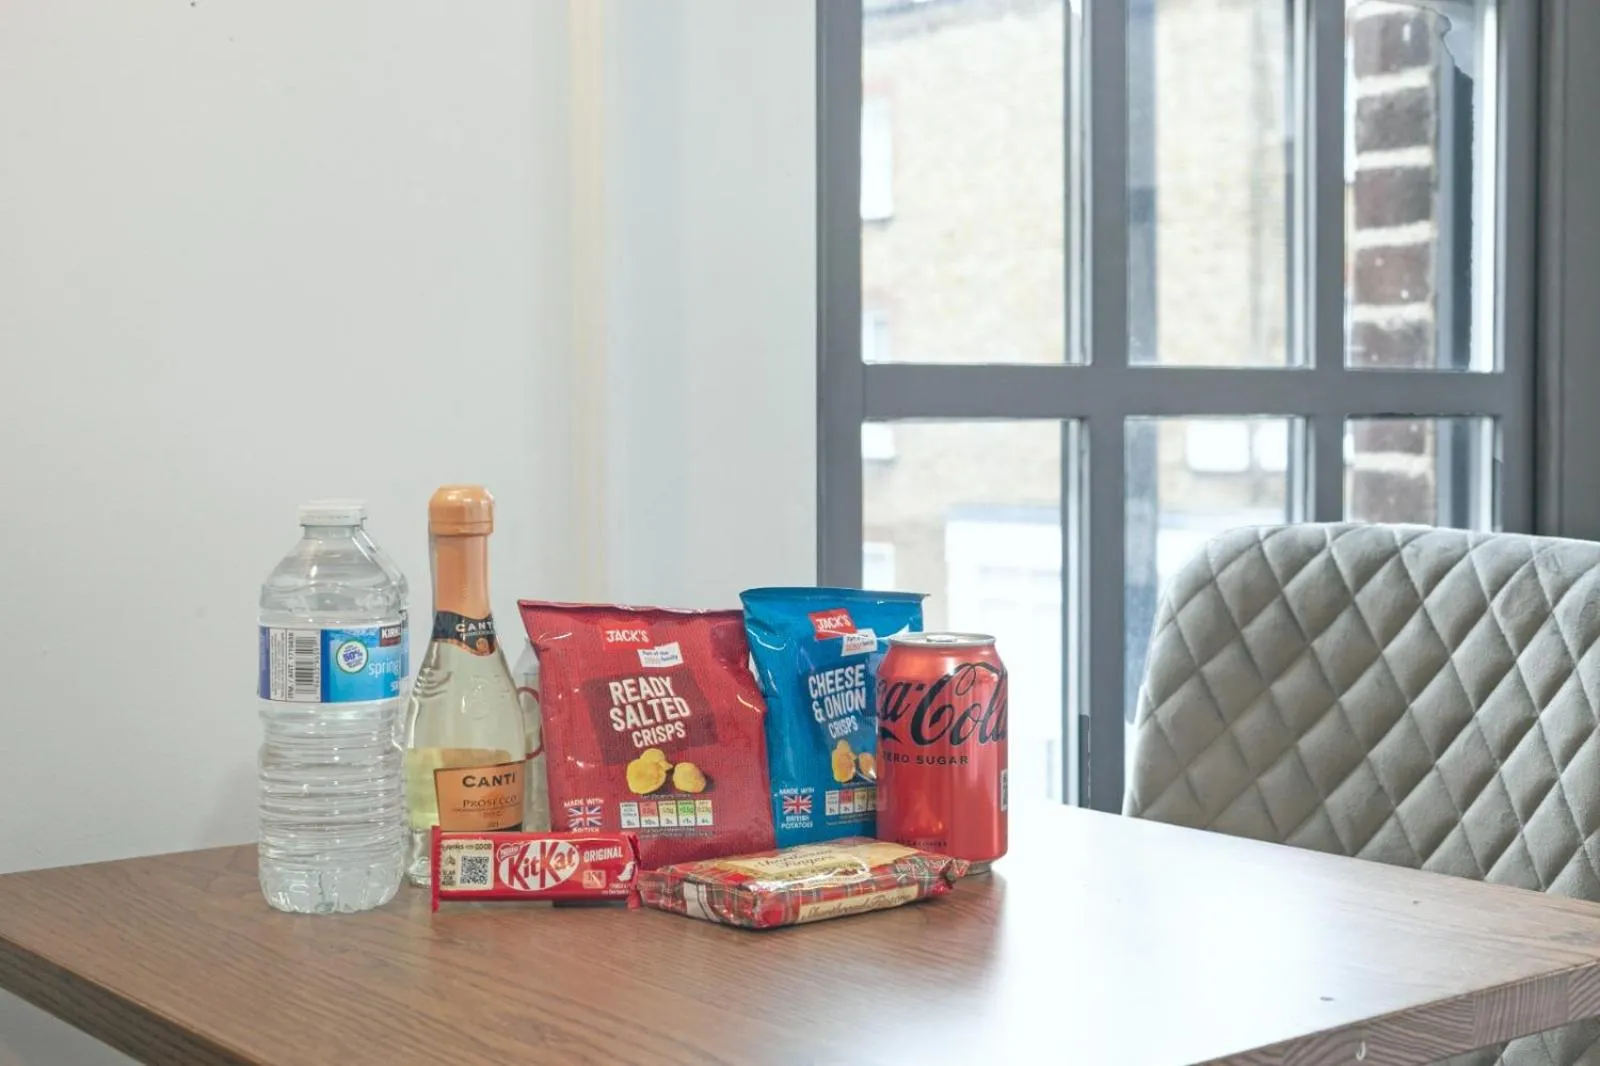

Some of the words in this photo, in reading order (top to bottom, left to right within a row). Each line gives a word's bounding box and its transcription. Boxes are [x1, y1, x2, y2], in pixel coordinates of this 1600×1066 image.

[815, 615, 852, 631] JACK'S
[605, 629, 650, 643] JACK'S
[609, 676, 675, 706] READY
[808, 664, 866, 699] CHEESE
[609, 697, 692, 732] SALTED
[812, 701, 825, 722] &
[824, 687, 867, 721] ONION
[632, 721, 687, 748] CRISPS
[828, 715, 859, 739] CRISPS
[916, 755, 969, 765] SUGAR
[462, 772, 516, 788] CANTI
[563, 799, 583, 808] MADE
[586, 798, 604, 807] WITH
[508, 841, 578, 890] KitKat
[583, 846, 623, 863] ORIGINAL
